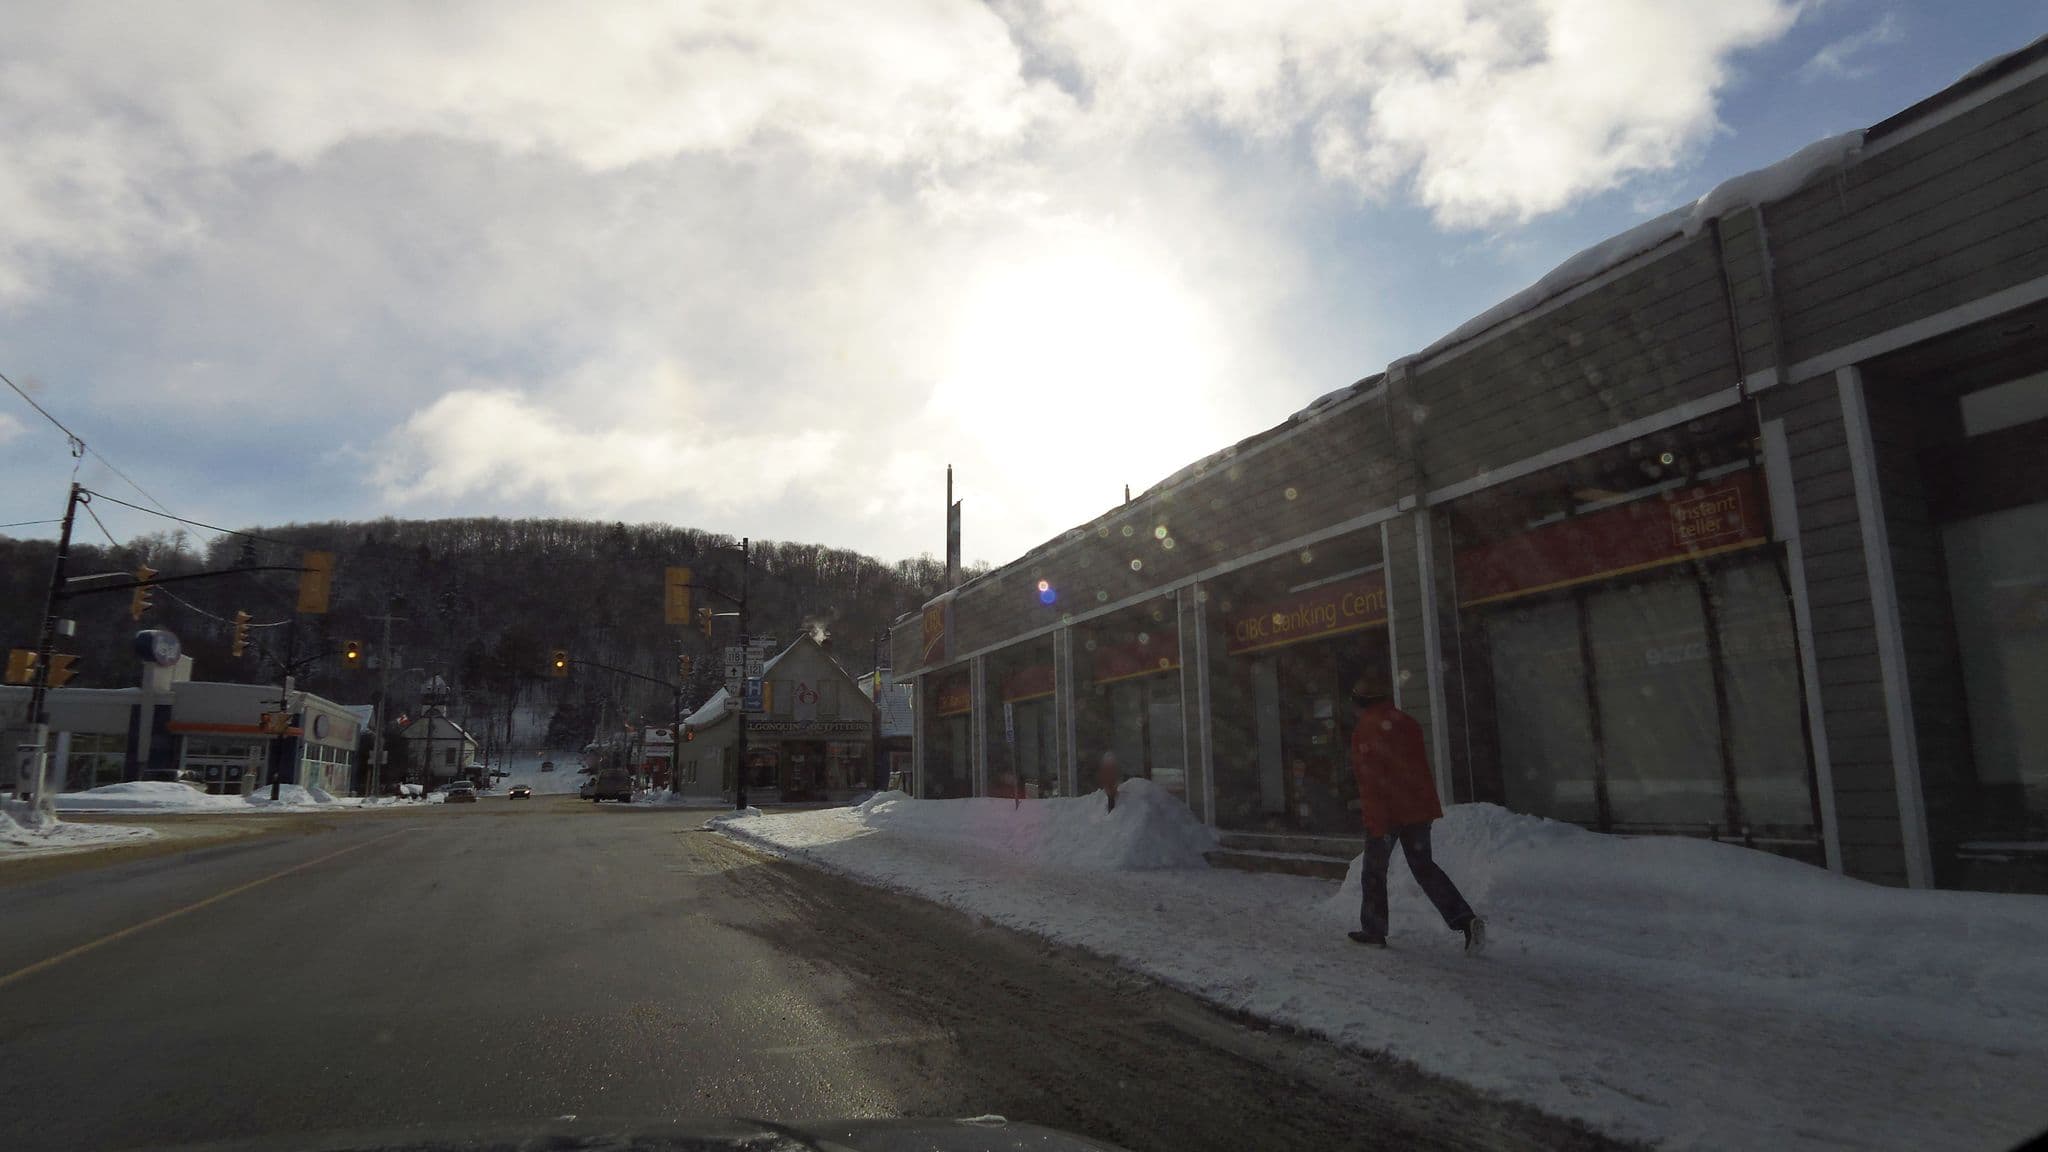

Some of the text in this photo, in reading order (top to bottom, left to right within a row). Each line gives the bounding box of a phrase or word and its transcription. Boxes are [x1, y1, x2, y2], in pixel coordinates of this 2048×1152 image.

[1679, 518, 1722, 538] teller
[1236, 586, 1387, 642] CIBC Banking Cent
